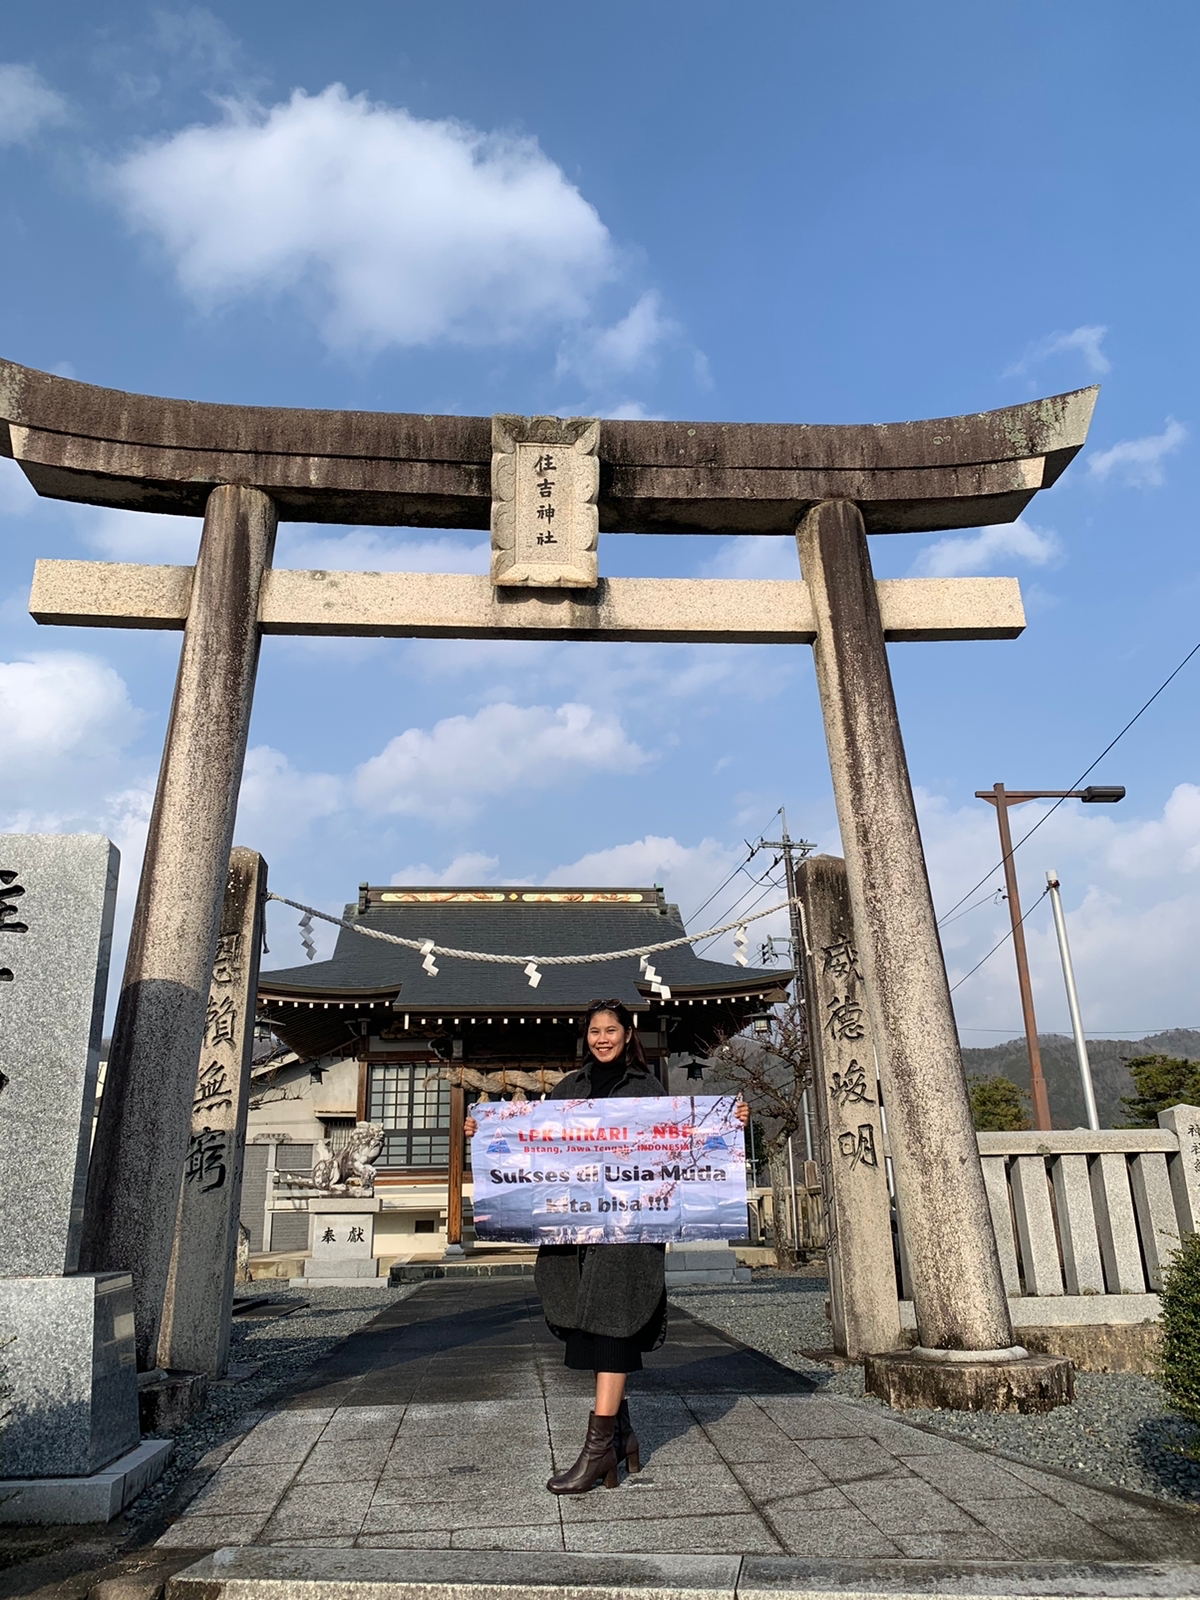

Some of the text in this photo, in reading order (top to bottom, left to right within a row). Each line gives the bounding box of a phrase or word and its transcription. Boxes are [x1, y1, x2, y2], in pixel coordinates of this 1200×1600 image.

[534, 454, 557, 546] 住吉神社
[518, 1129, 554, 1142] LPK
[561, 1127, 628, 1141] HIKARI
[523, 1143, 690, 1154] Batang, Jawa Tengah, INDONESIA
[490, 1164, 726, 1184] Sukses di Usia Muda
[598, 1196, 642, 1212] bisa
[648, 1196, 669, 1212] !!!
